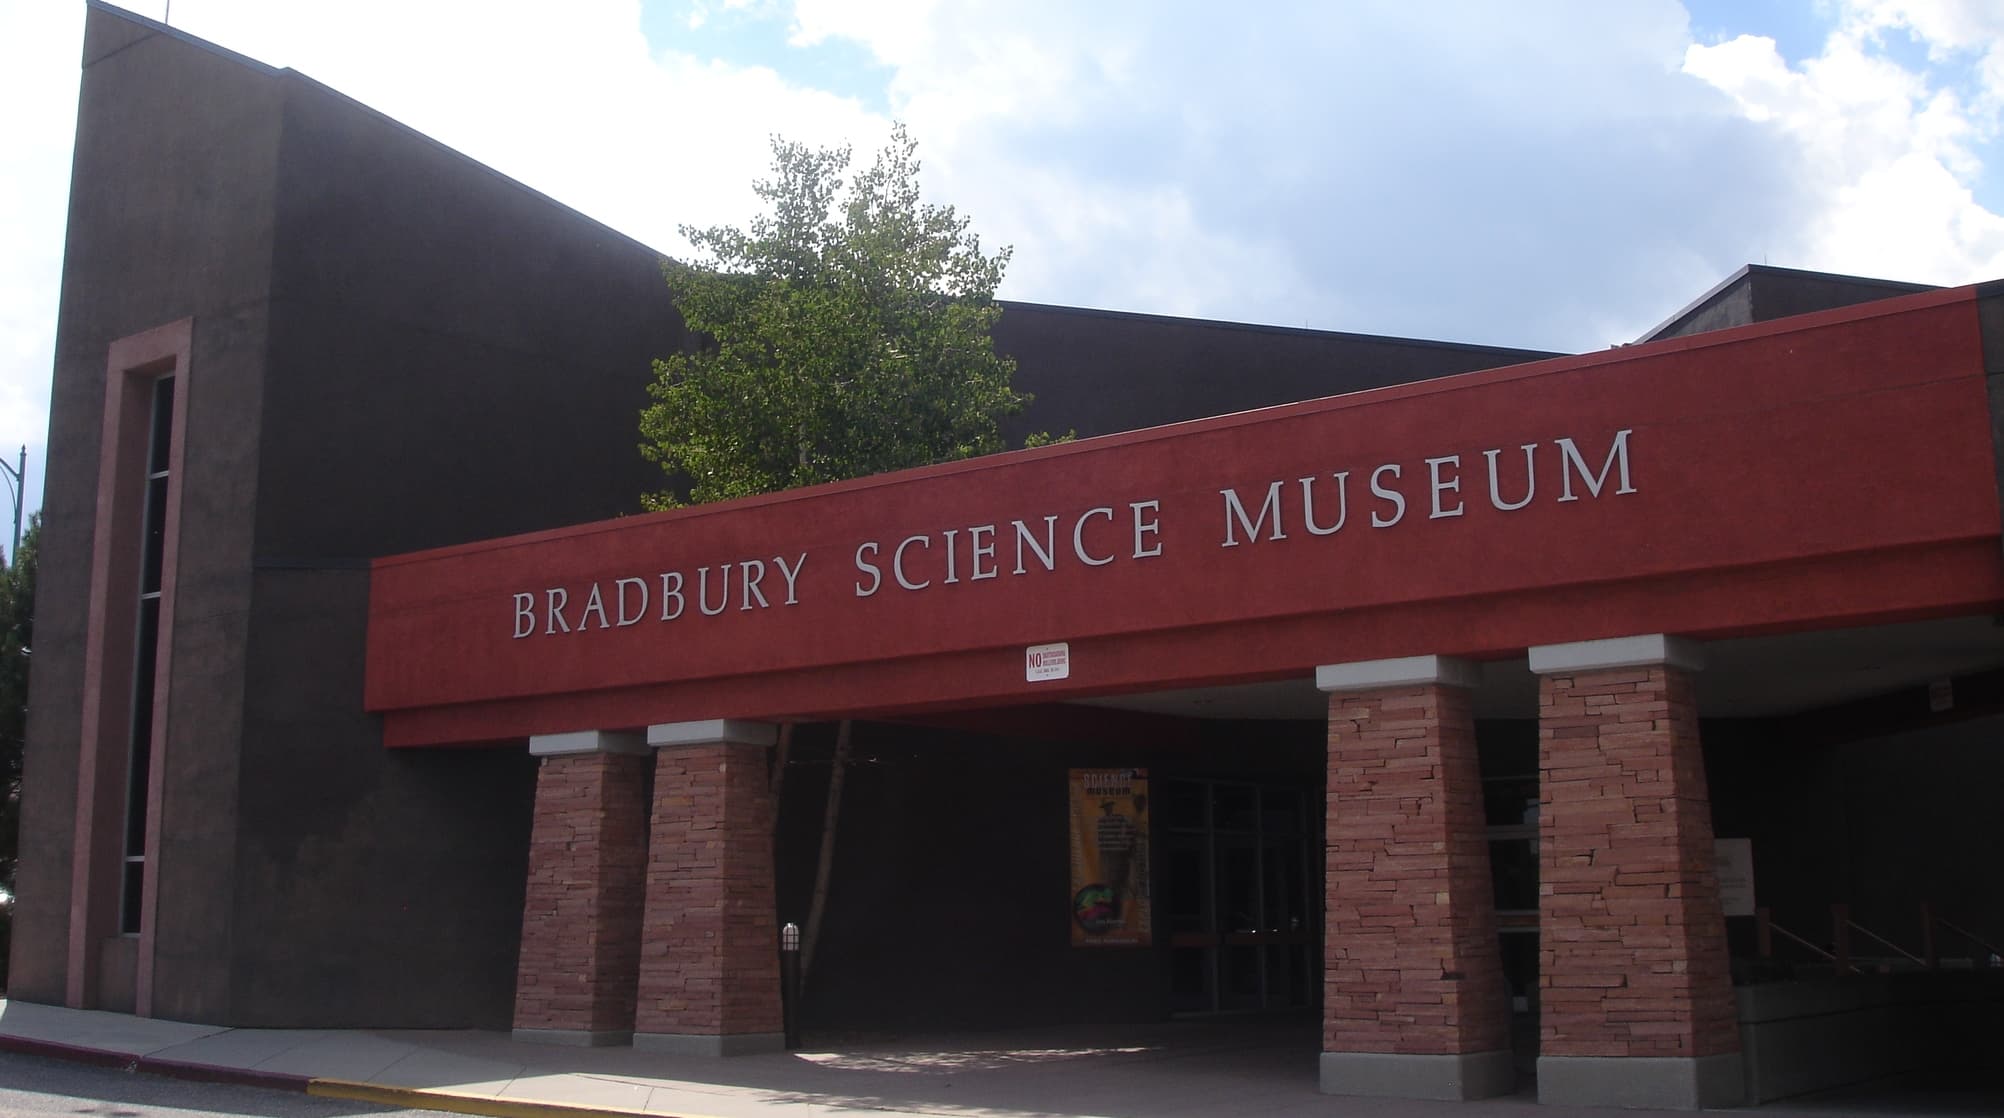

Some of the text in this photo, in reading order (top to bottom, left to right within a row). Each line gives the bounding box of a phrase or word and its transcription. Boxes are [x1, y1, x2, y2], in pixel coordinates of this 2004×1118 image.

[512, 429, 1637, 639] BRADBURY SCIENCE MUSEUM
[1029, 653, 1042, 669] NO
